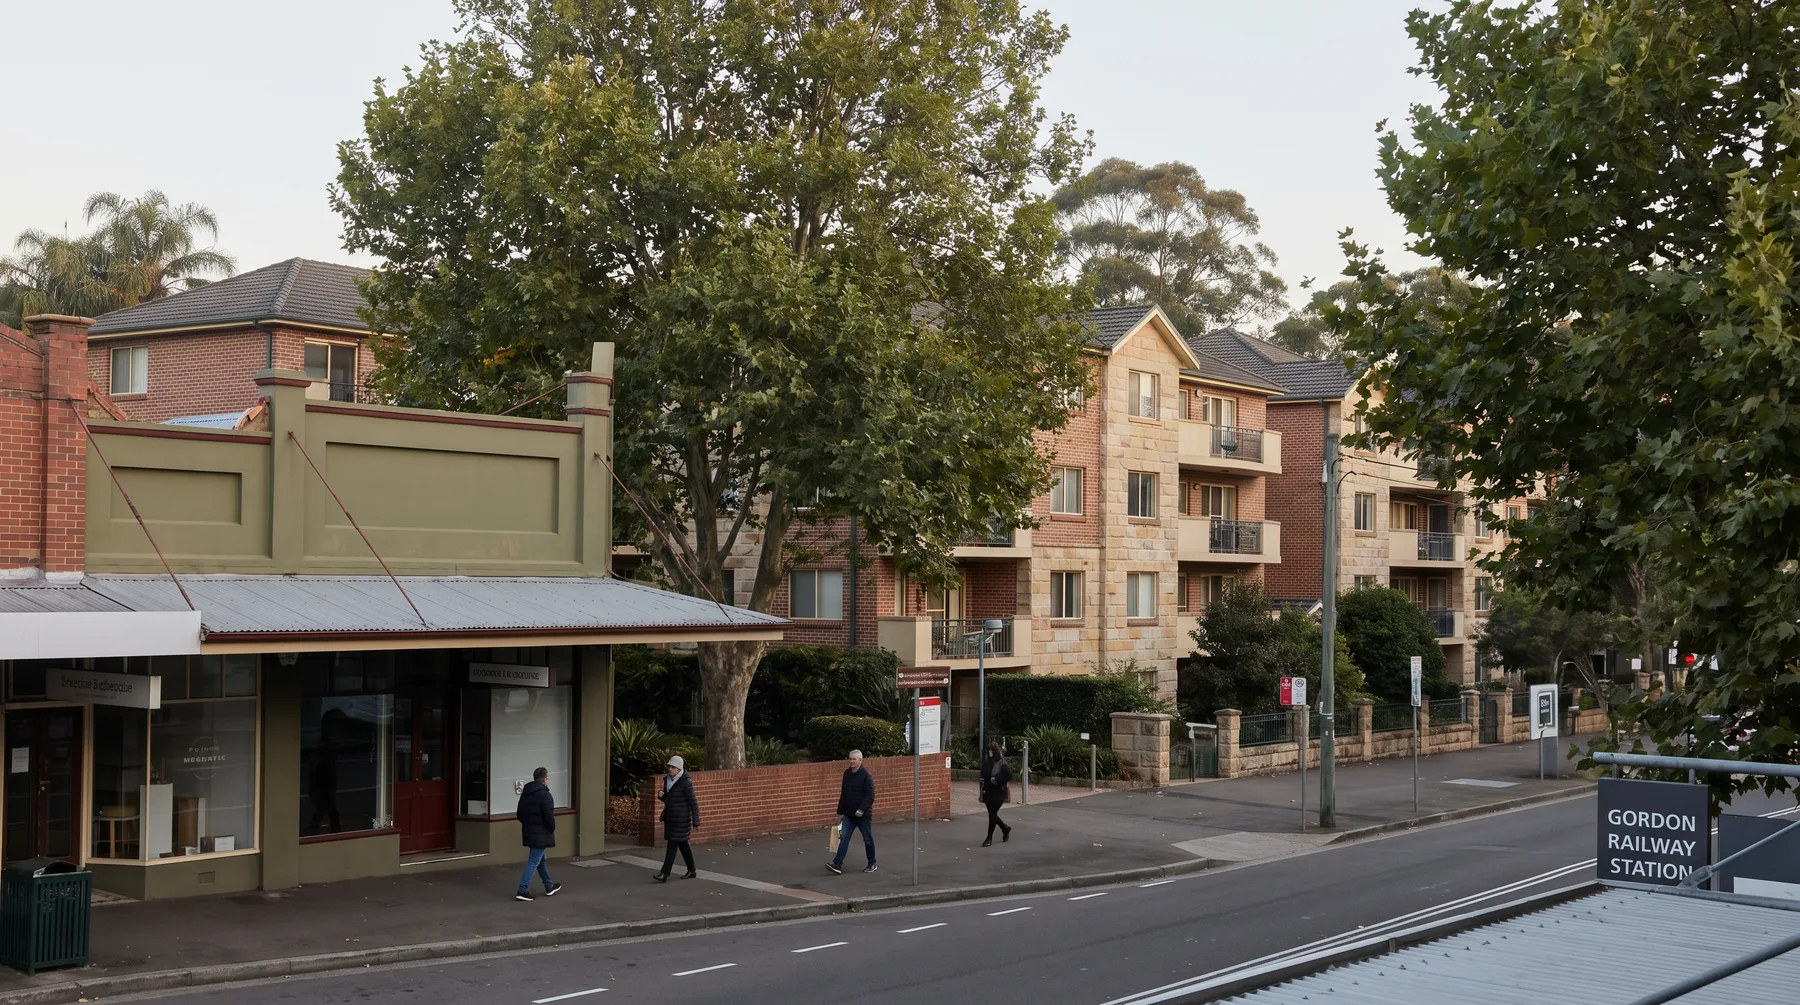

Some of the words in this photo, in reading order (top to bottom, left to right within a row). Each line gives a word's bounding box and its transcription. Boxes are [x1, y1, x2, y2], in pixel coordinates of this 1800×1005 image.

[1608, 809, 1696, 832] GORDON
[1608, 833, 1697, 857] RAILWAY
[1610, 858, 1693, 881] STATION
